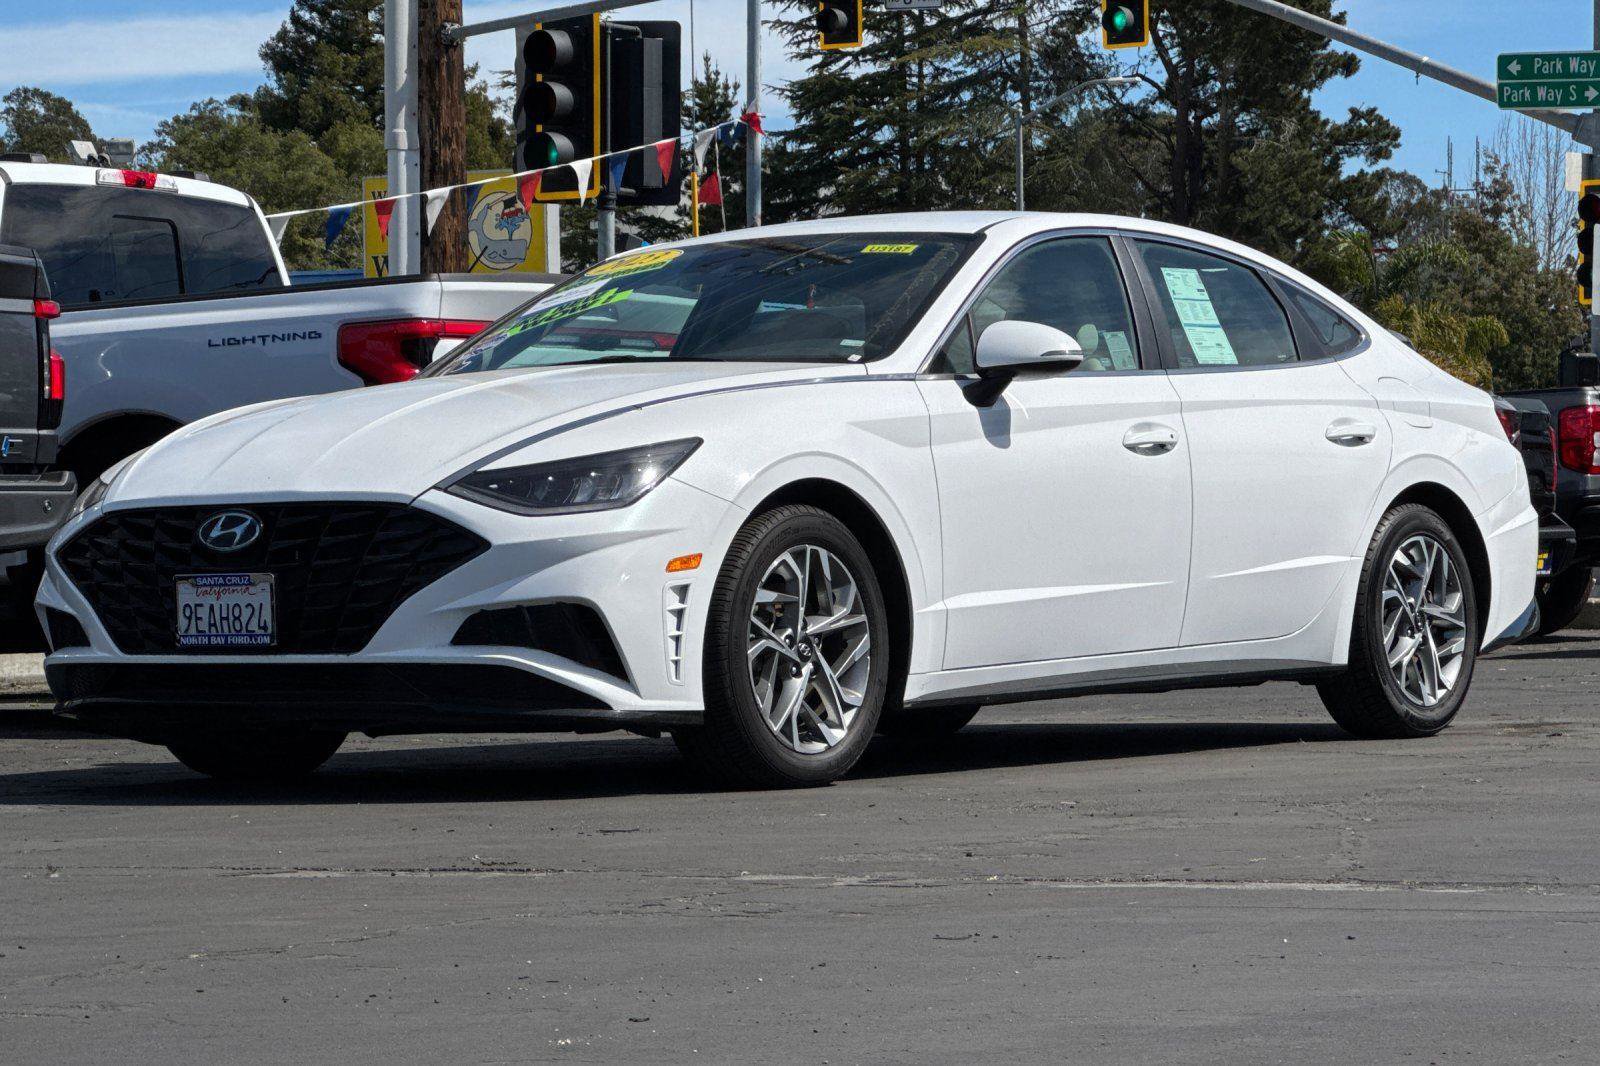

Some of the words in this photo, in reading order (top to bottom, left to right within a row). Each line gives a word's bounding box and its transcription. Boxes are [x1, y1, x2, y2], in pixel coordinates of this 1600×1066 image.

[1534, 57, 1563, 74] Park
[1569, 56, 1596, 77] Way
[1503, 86, 1531, 102] Park
[1537, 85, 1563, 105] Way
[1569, 84, 1577, 101] S
[207, 330, 322, 348] LIGHTNING
[196, 577, 224, 585] SANTA
[225, 576, 249, 584] CRUZ
[196, 586, 256, 600] California
[182, 602, 269, 634] 9EAH824
[180, 636, 209, 645] NORTH
[210, 636, 226, 645] BAY
[228, 636, 270, 644] FORD.COM
